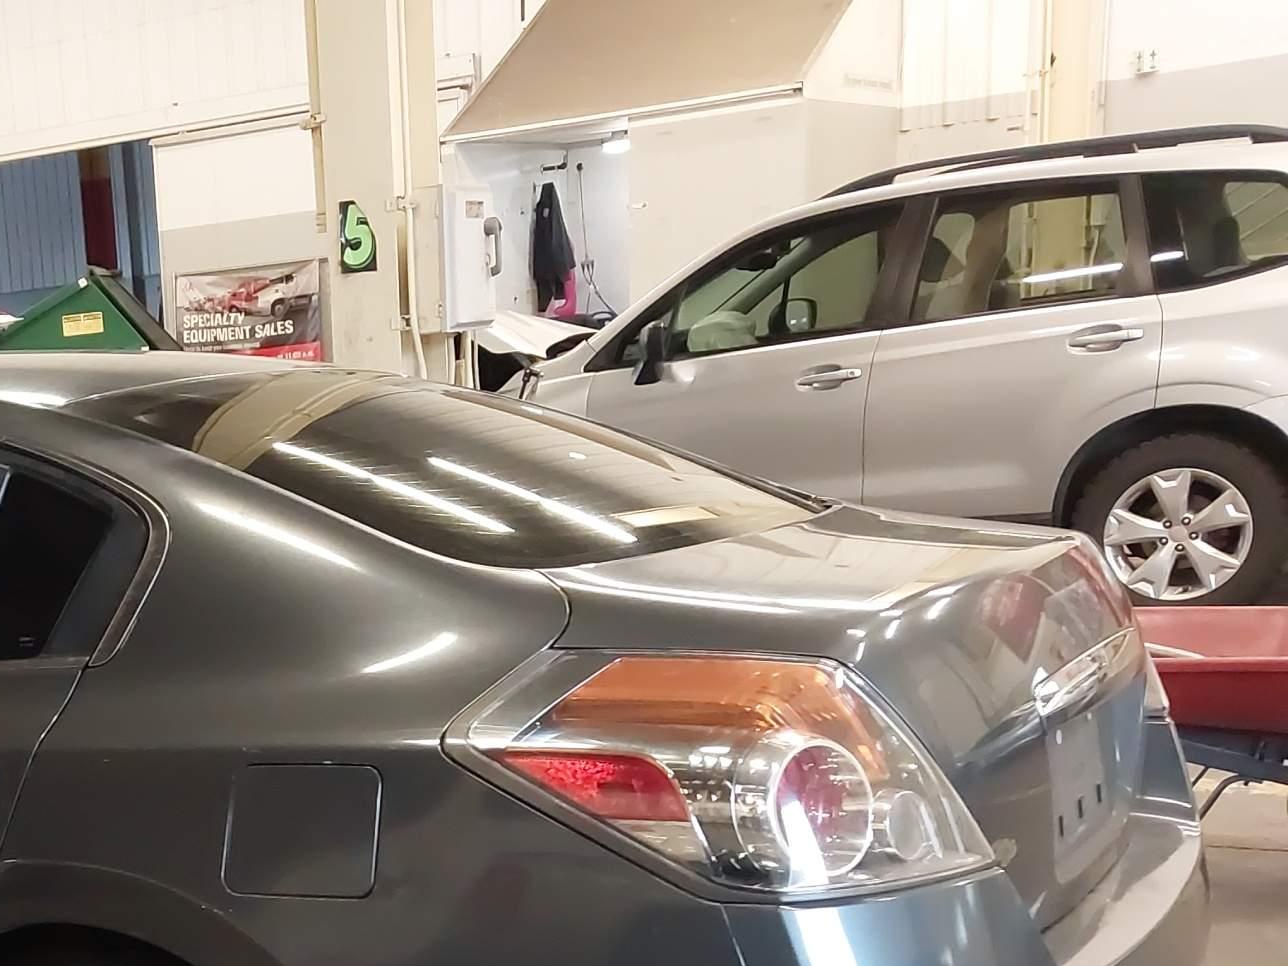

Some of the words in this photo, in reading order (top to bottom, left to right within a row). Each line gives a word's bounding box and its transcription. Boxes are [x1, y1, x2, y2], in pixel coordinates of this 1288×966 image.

[343, 203, 376, 269] 5
[183, 312, 245, 329] SPECIALTY
[183, 325, 252, 343] EQUIPMENT
[254, 319, 294, 339] SALES
